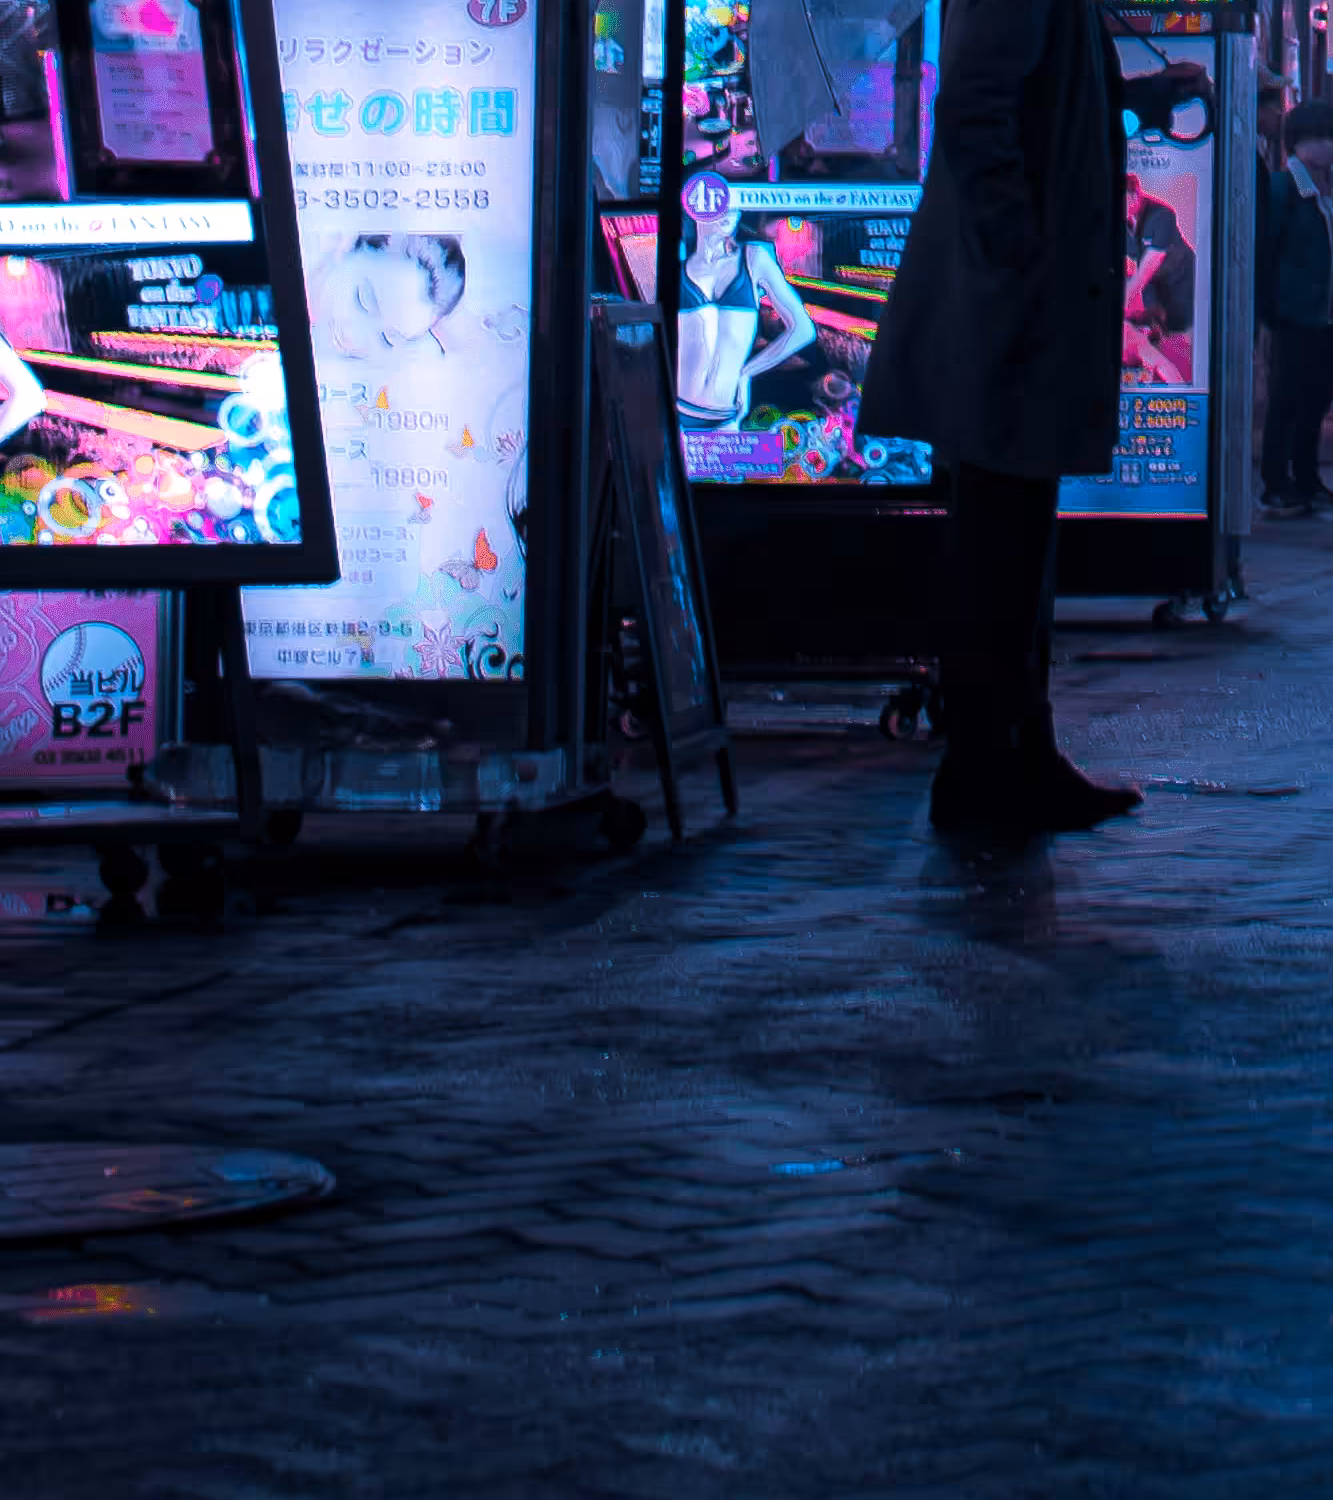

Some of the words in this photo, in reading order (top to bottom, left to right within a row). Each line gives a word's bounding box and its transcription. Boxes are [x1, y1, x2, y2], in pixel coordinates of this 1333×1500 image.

[279, 38, 494, 67] リラクゼーション
[52, 701, 146, 738] B2F
